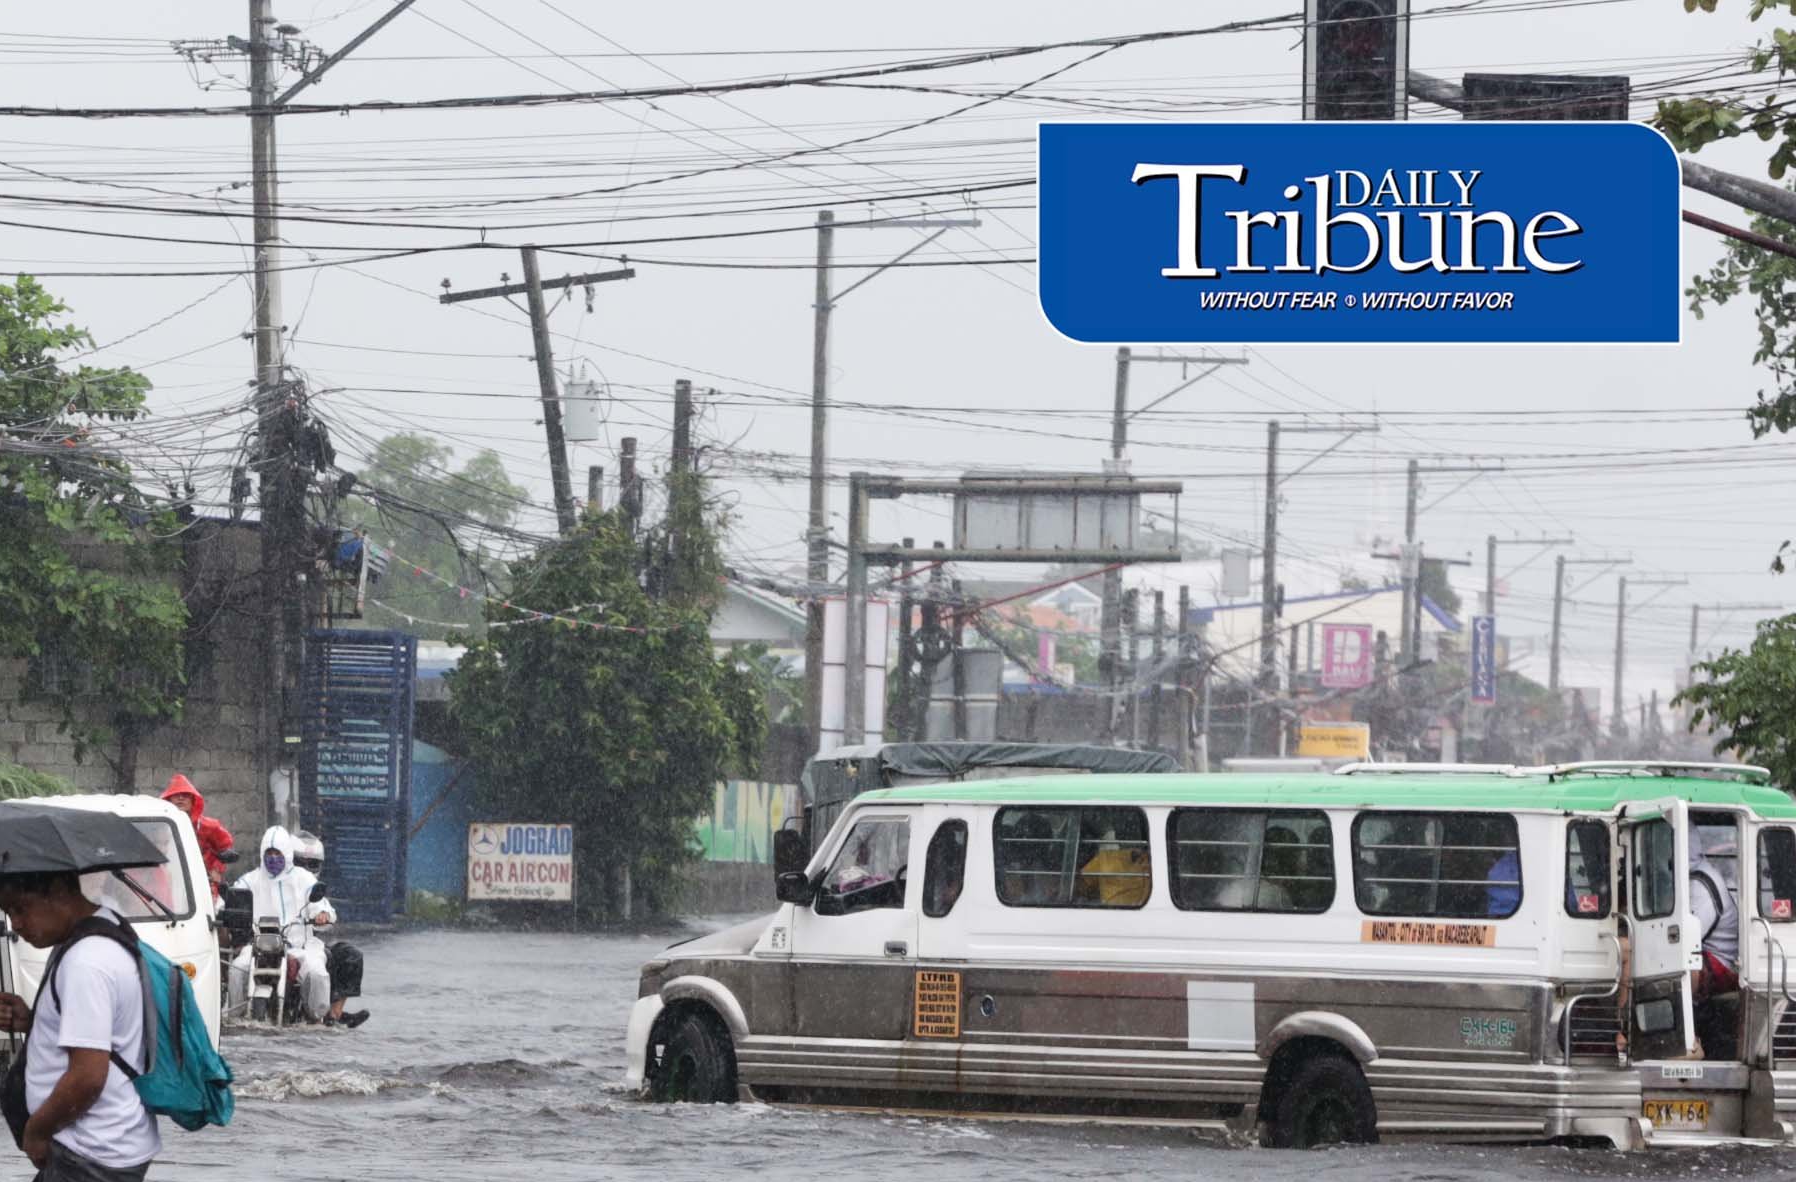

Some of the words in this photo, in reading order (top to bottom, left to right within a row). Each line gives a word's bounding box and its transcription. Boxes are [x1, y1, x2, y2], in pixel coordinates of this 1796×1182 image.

[500, 826, 573, 856] JOGRAD
[471, 862, 504, 883] CAR
[1645, 1102, 1673, 1121] CXK
[1679, 1103, 1705, 1121] 164
